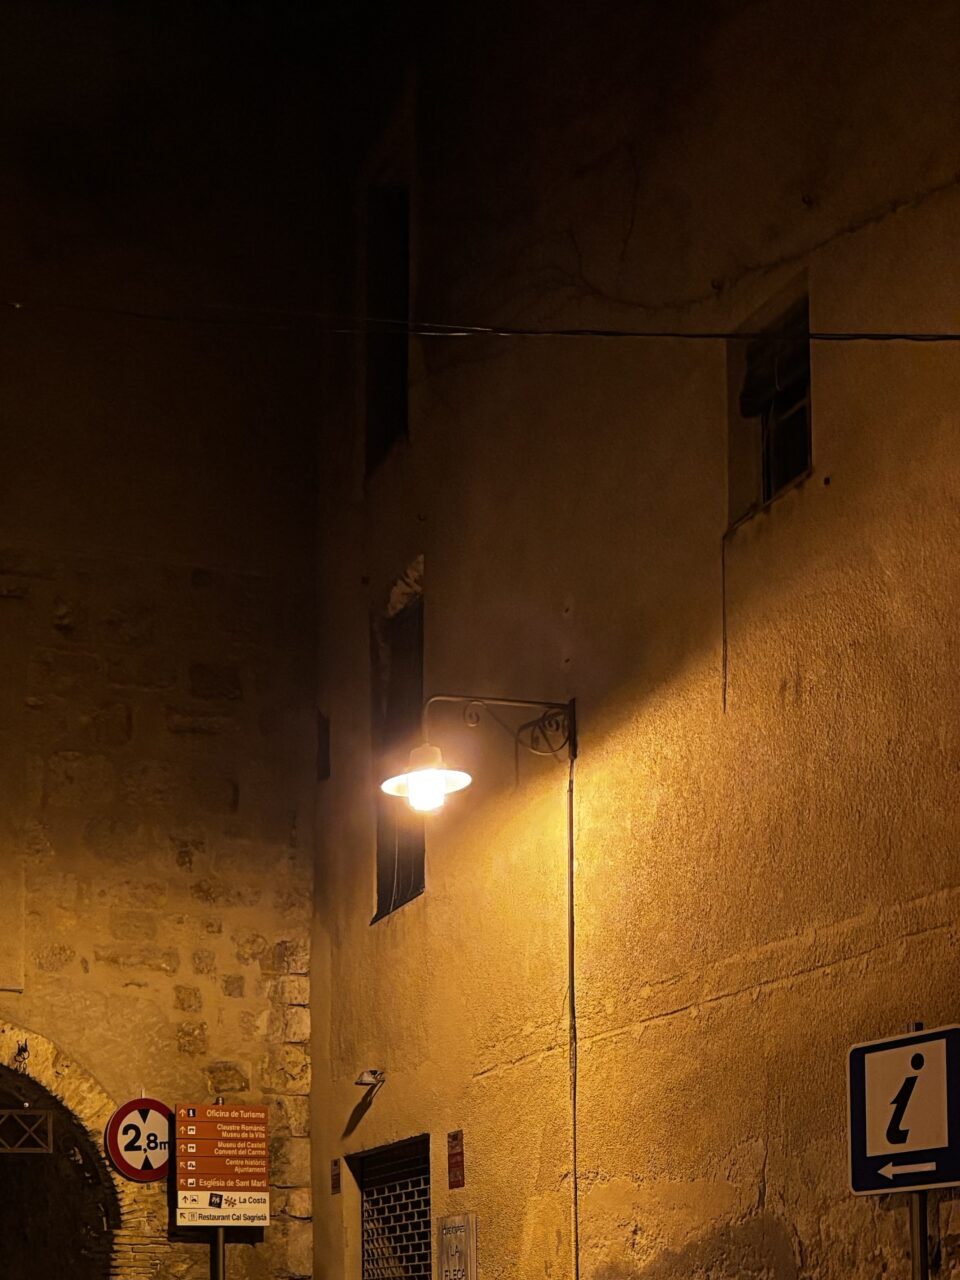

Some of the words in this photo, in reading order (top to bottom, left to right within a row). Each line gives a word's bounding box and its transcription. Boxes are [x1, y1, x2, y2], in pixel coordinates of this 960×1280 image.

[235, 1166, 265, 1174] Ajuntament
[199, 1177, 225, 1188] Església
[226, 1179, 235, 1187] de
[236, 1179, 250, 1187] Sant
[448, 1244, 460, 1257] LA
[444, 1268, 465, 1280] FLECA
